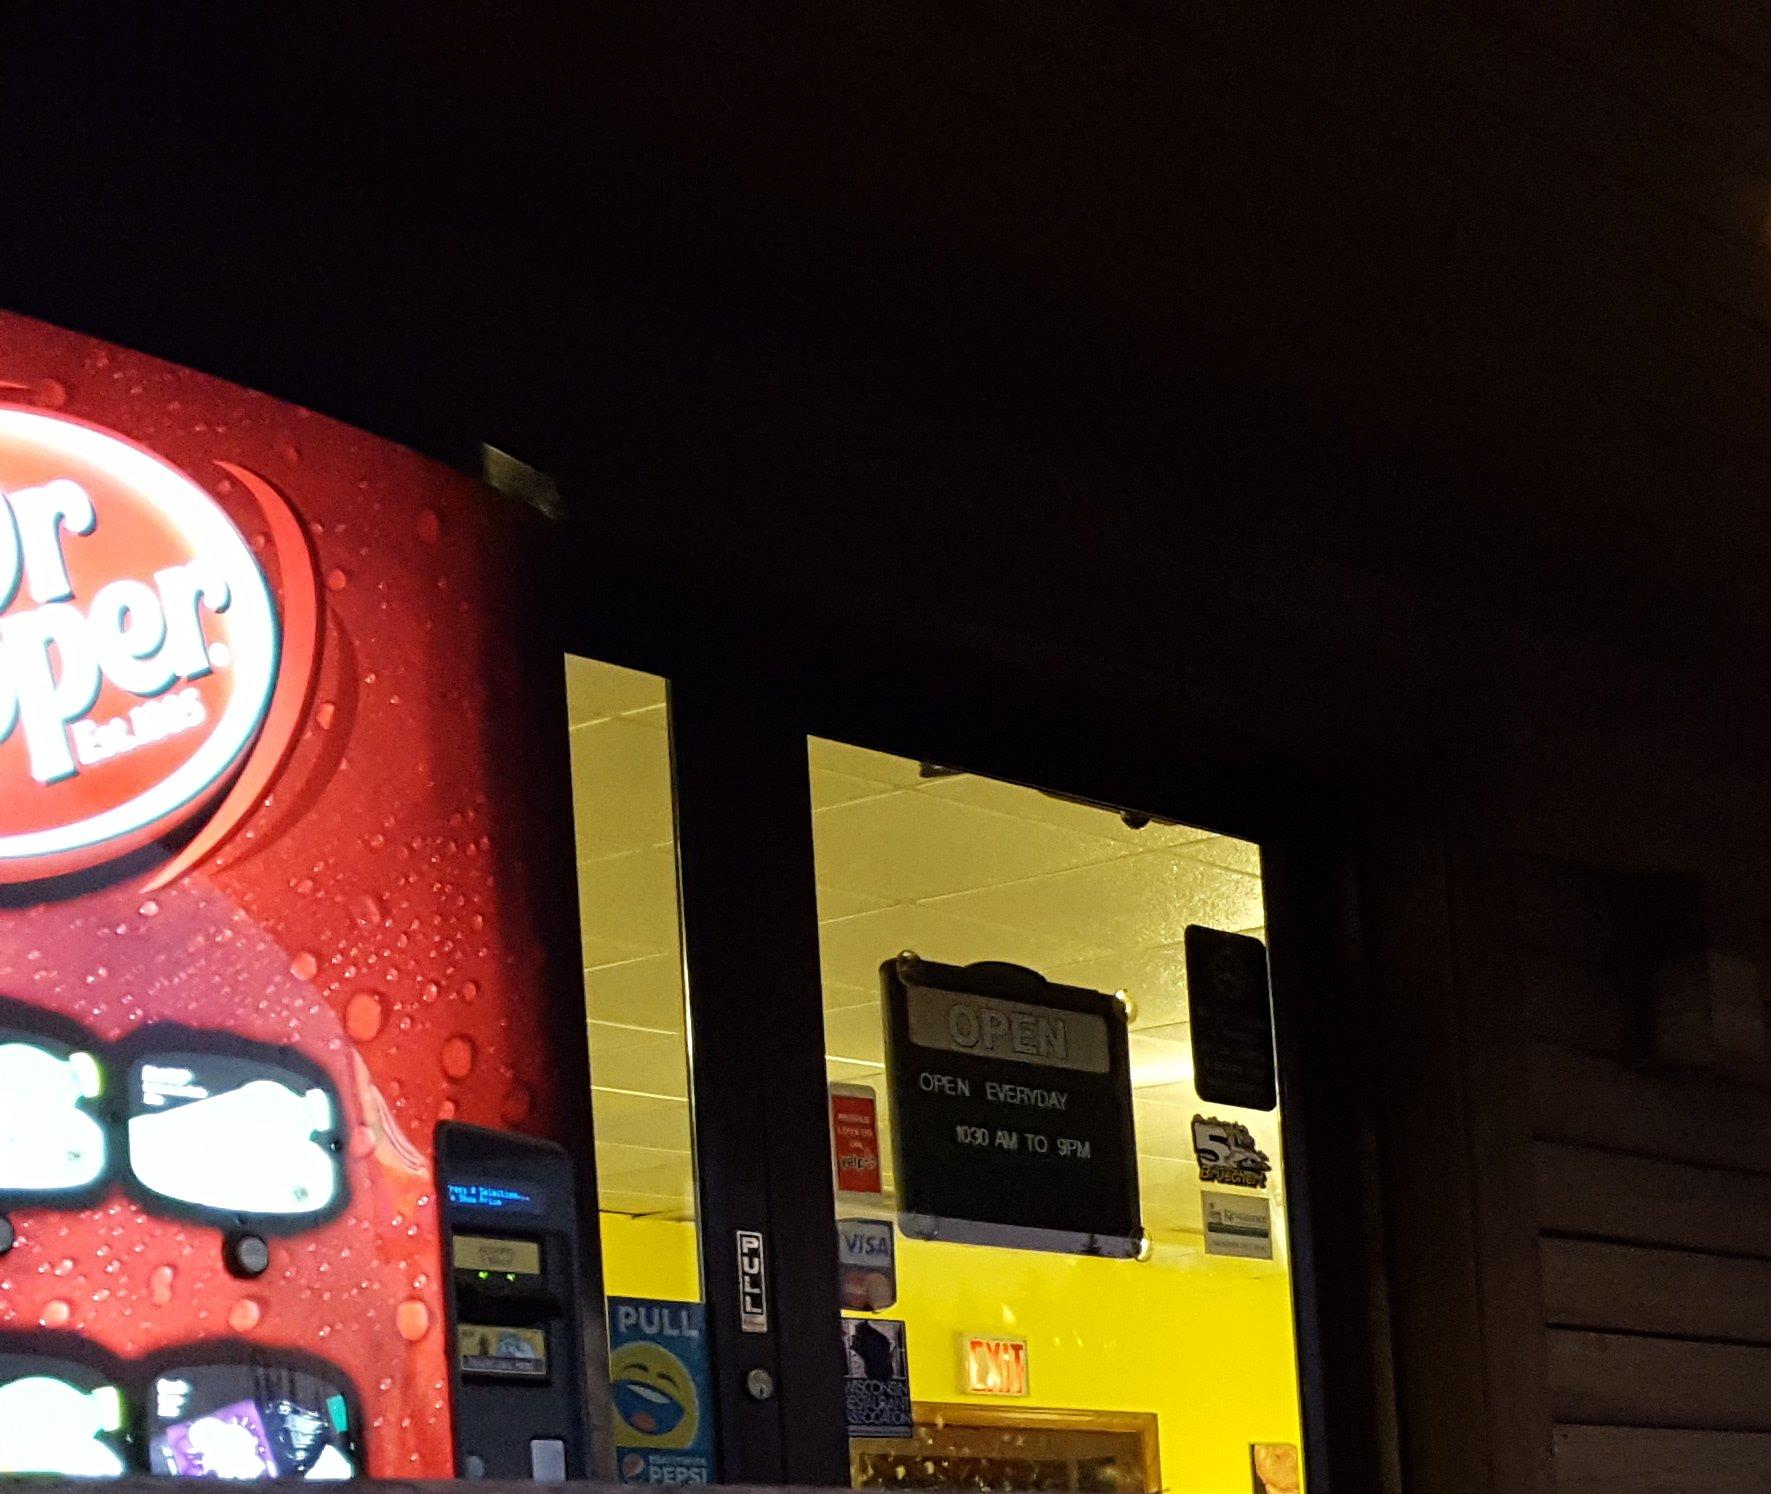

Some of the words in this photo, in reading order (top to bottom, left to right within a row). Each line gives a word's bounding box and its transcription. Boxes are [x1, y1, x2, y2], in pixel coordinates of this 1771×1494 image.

[0, 479, 97, 616] r
[950, 1004, 1068, 1060] OPEN
[920, 1072, 971, 1097] OPEN
[985, 1081, 1068, 1110] EVERYDAY
[995, 1130, 1018, 1149] AM
[1024, 1134, 1048, 1153] TO
[1057, 1138, 1091, 1159] 9PM
[842, 1233, 889, 1256] VISA
[741, 1236, 763, 1313] PULL
[617, 1306, 700, 1337] PULL
[969, 1340, 1024, 1393] EXIT
[649, 1466, 708, 1486] PEPSI
